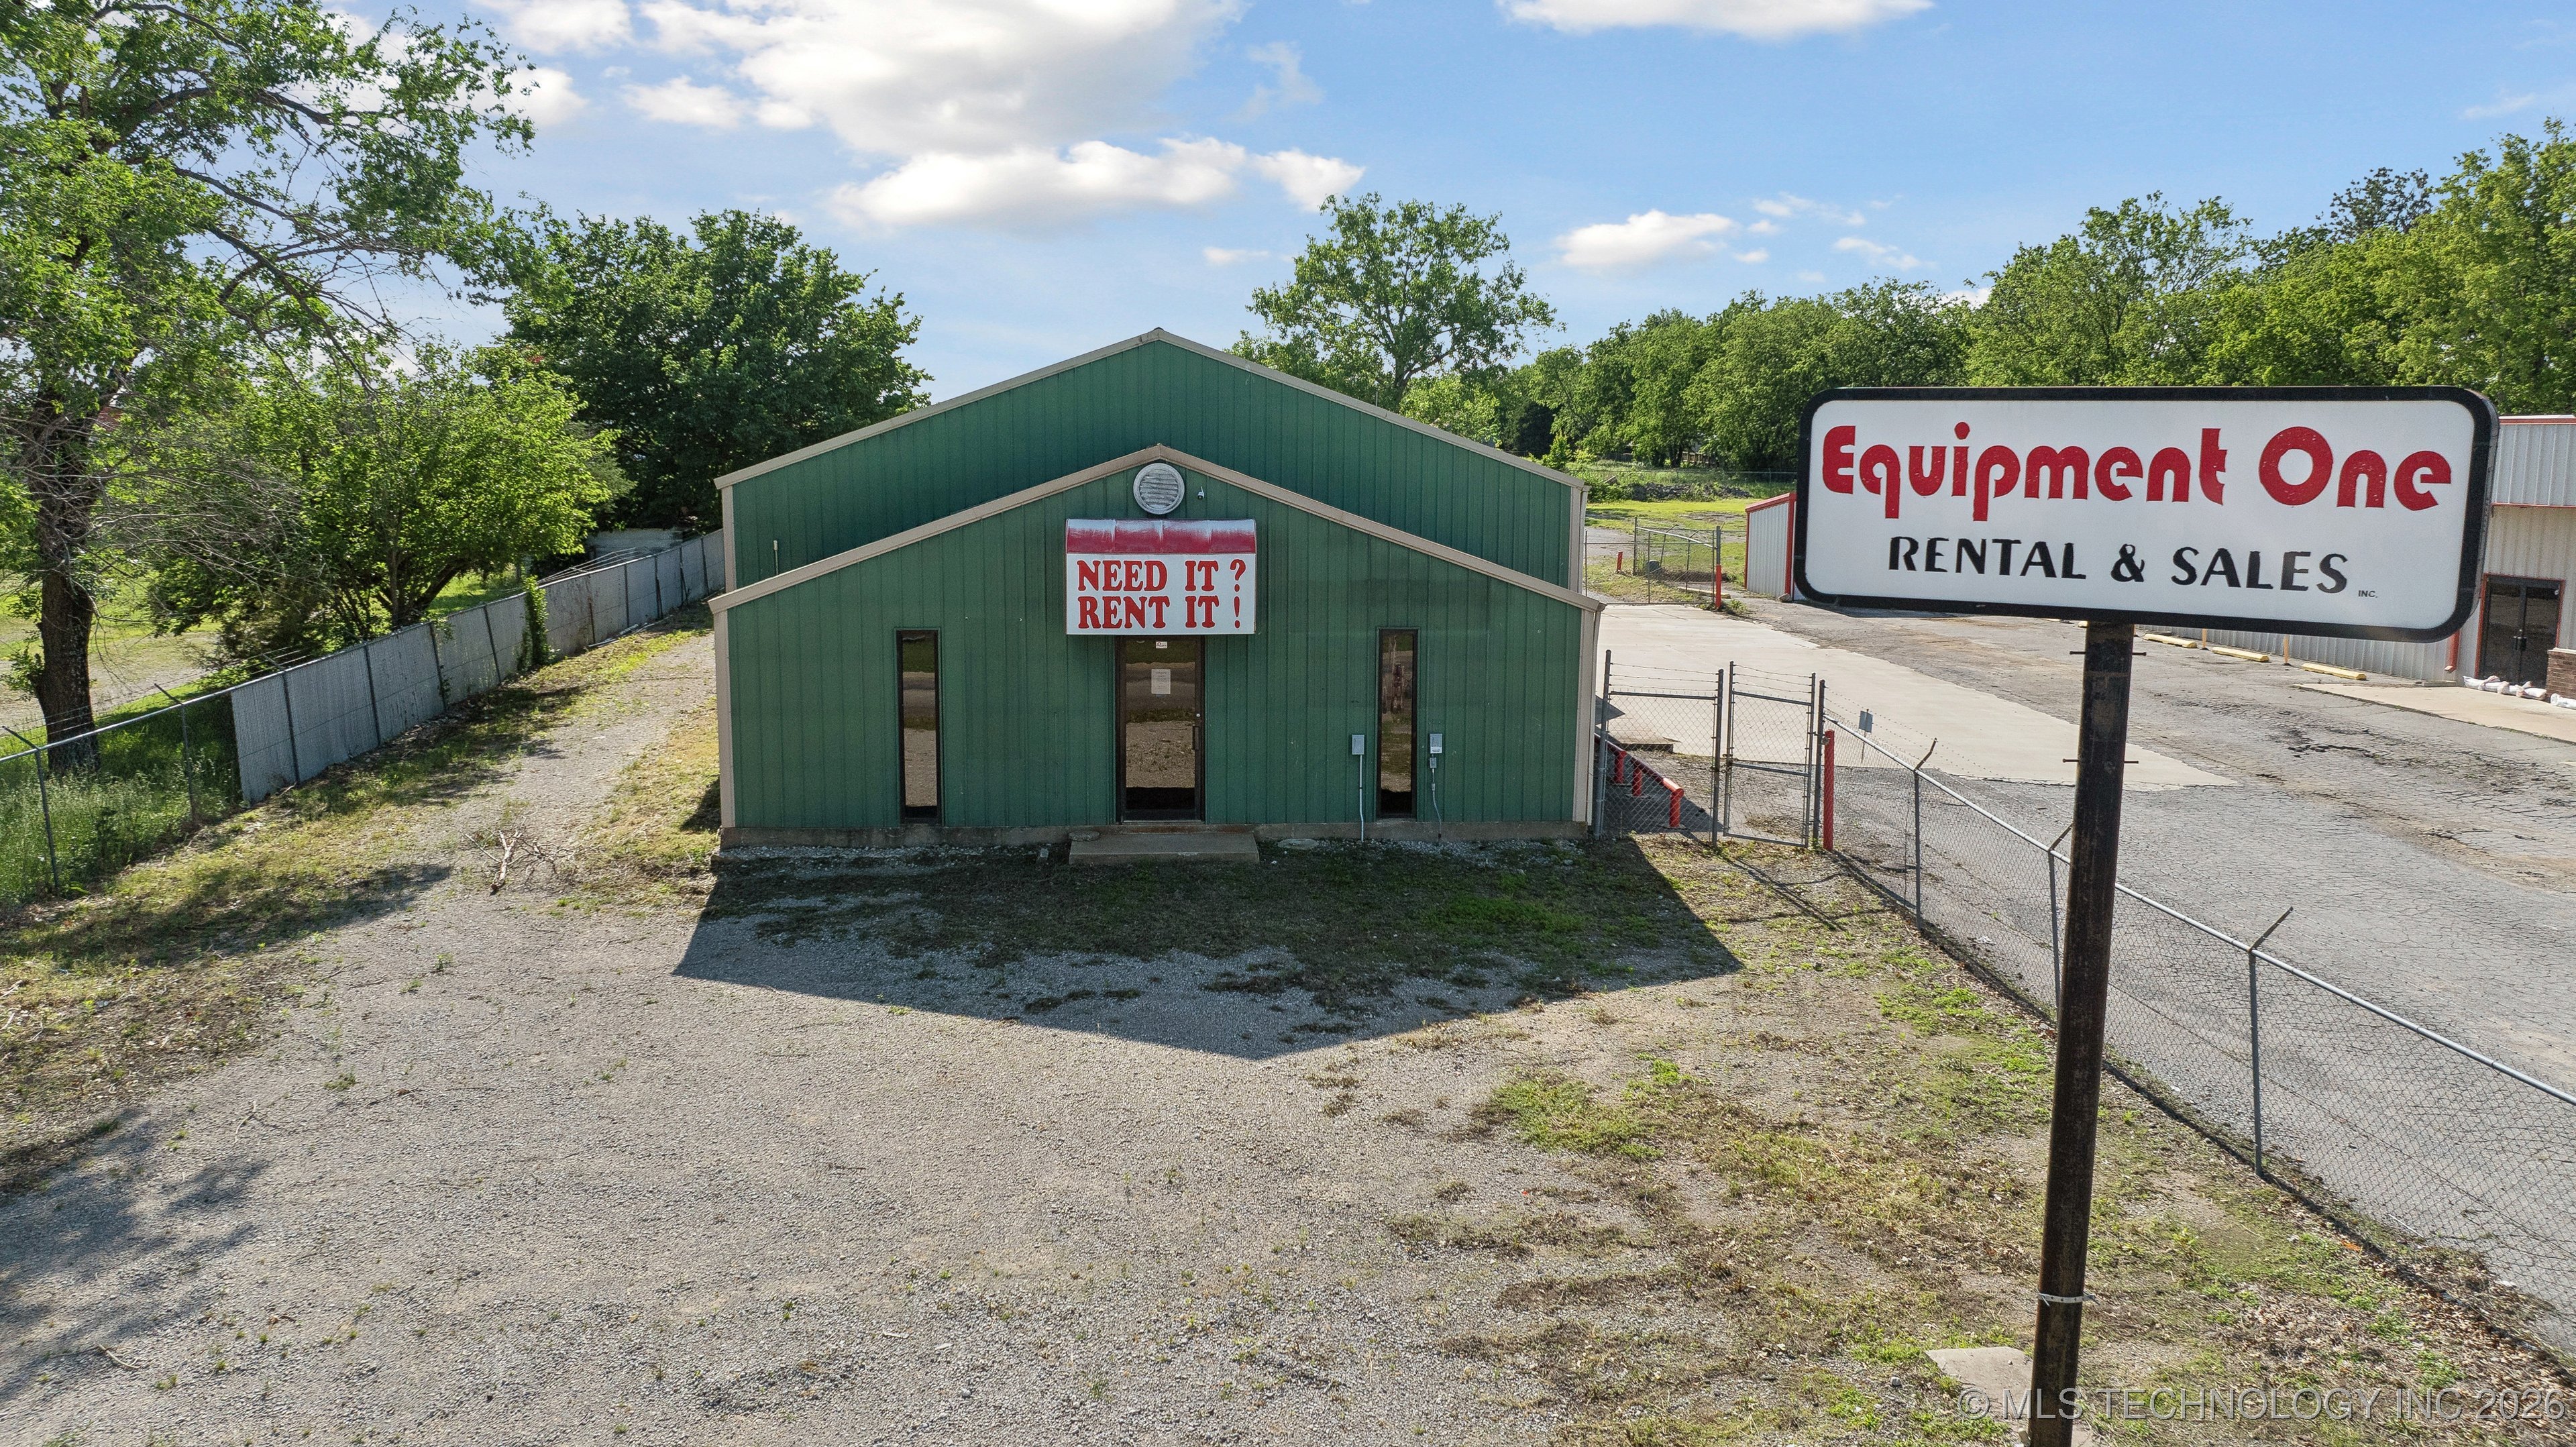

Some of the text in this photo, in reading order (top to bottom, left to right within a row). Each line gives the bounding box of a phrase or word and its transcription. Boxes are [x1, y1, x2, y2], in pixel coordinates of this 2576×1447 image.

[1822, 422, 2451, 522] Equipment One
[1077, 559, 1167, 591] NEED
[1888, 536, 2379, 598] RENTAL & SALES INC.
[1077, 596, 1170, 629] RENT
